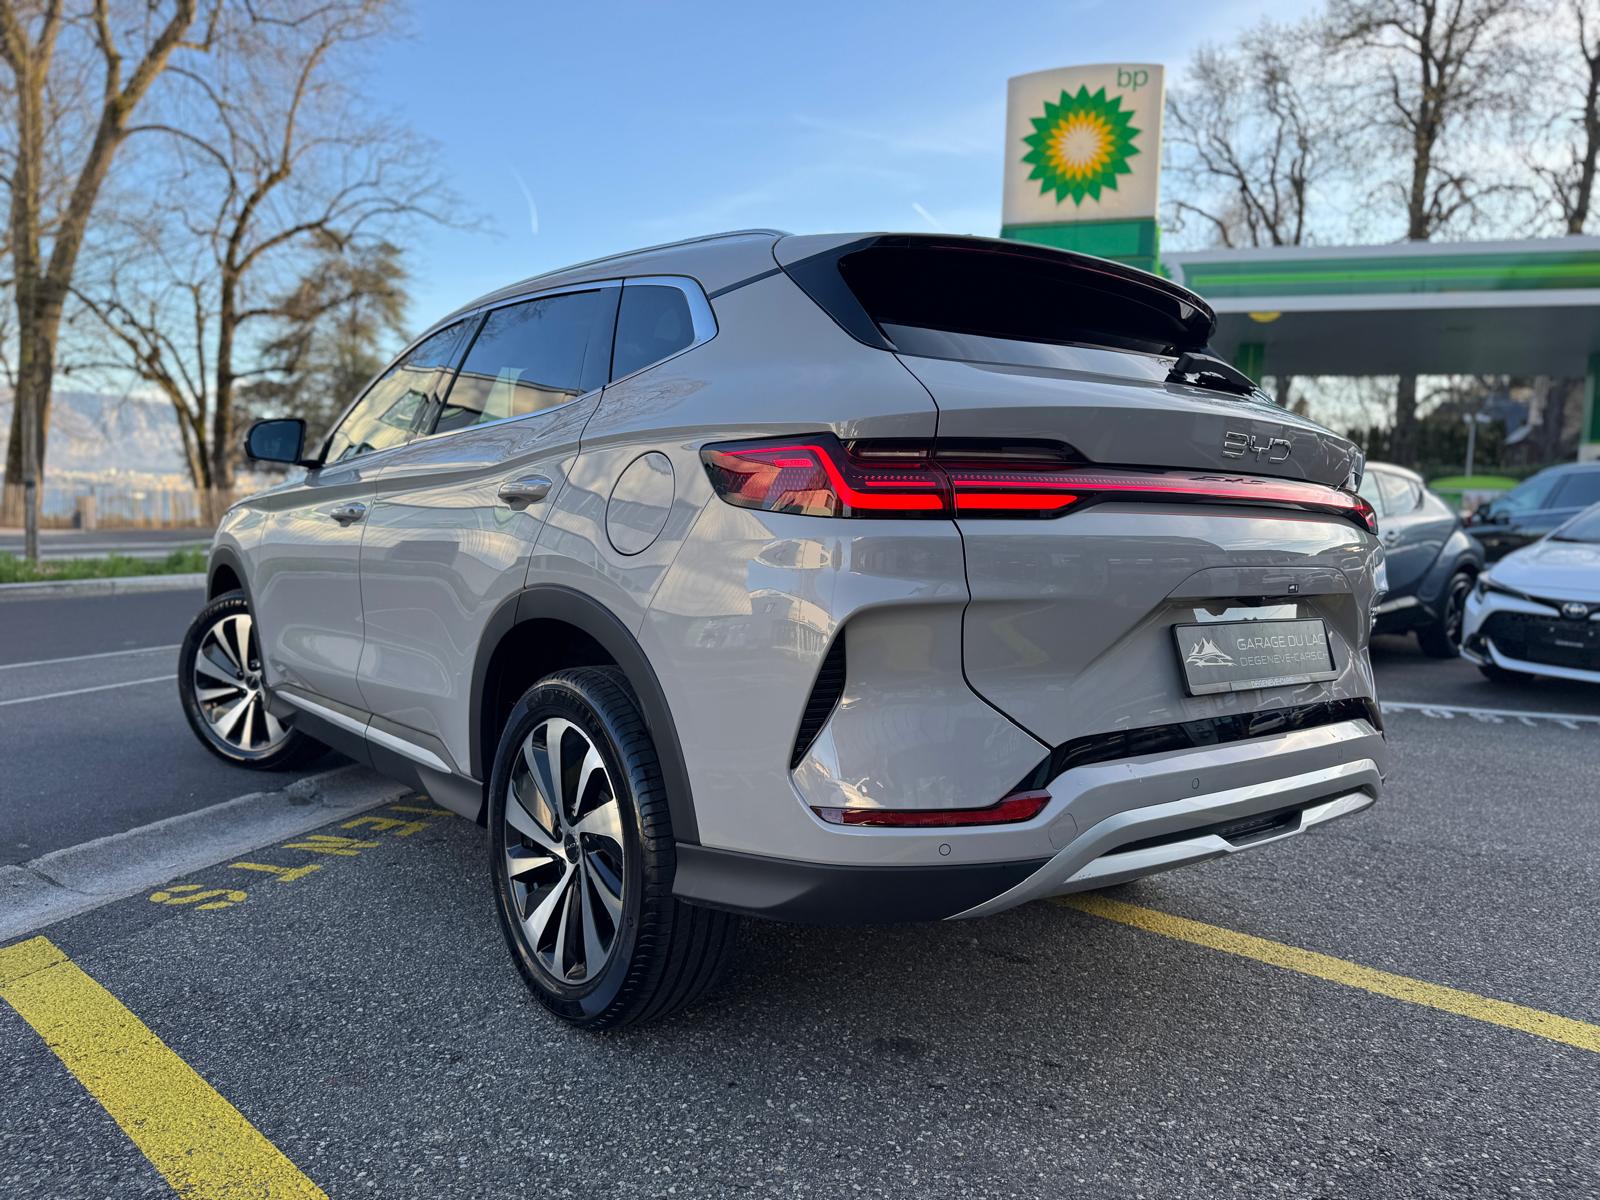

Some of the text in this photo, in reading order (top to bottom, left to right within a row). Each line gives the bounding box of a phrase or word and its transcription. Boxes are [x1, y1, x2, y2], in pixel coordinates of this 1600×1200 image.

[1117, 66, 1149, 92] bp
[1223, 431, 1292, 463] BYD
[1236, 633, 1327, 651] GARAGE DU LAC
